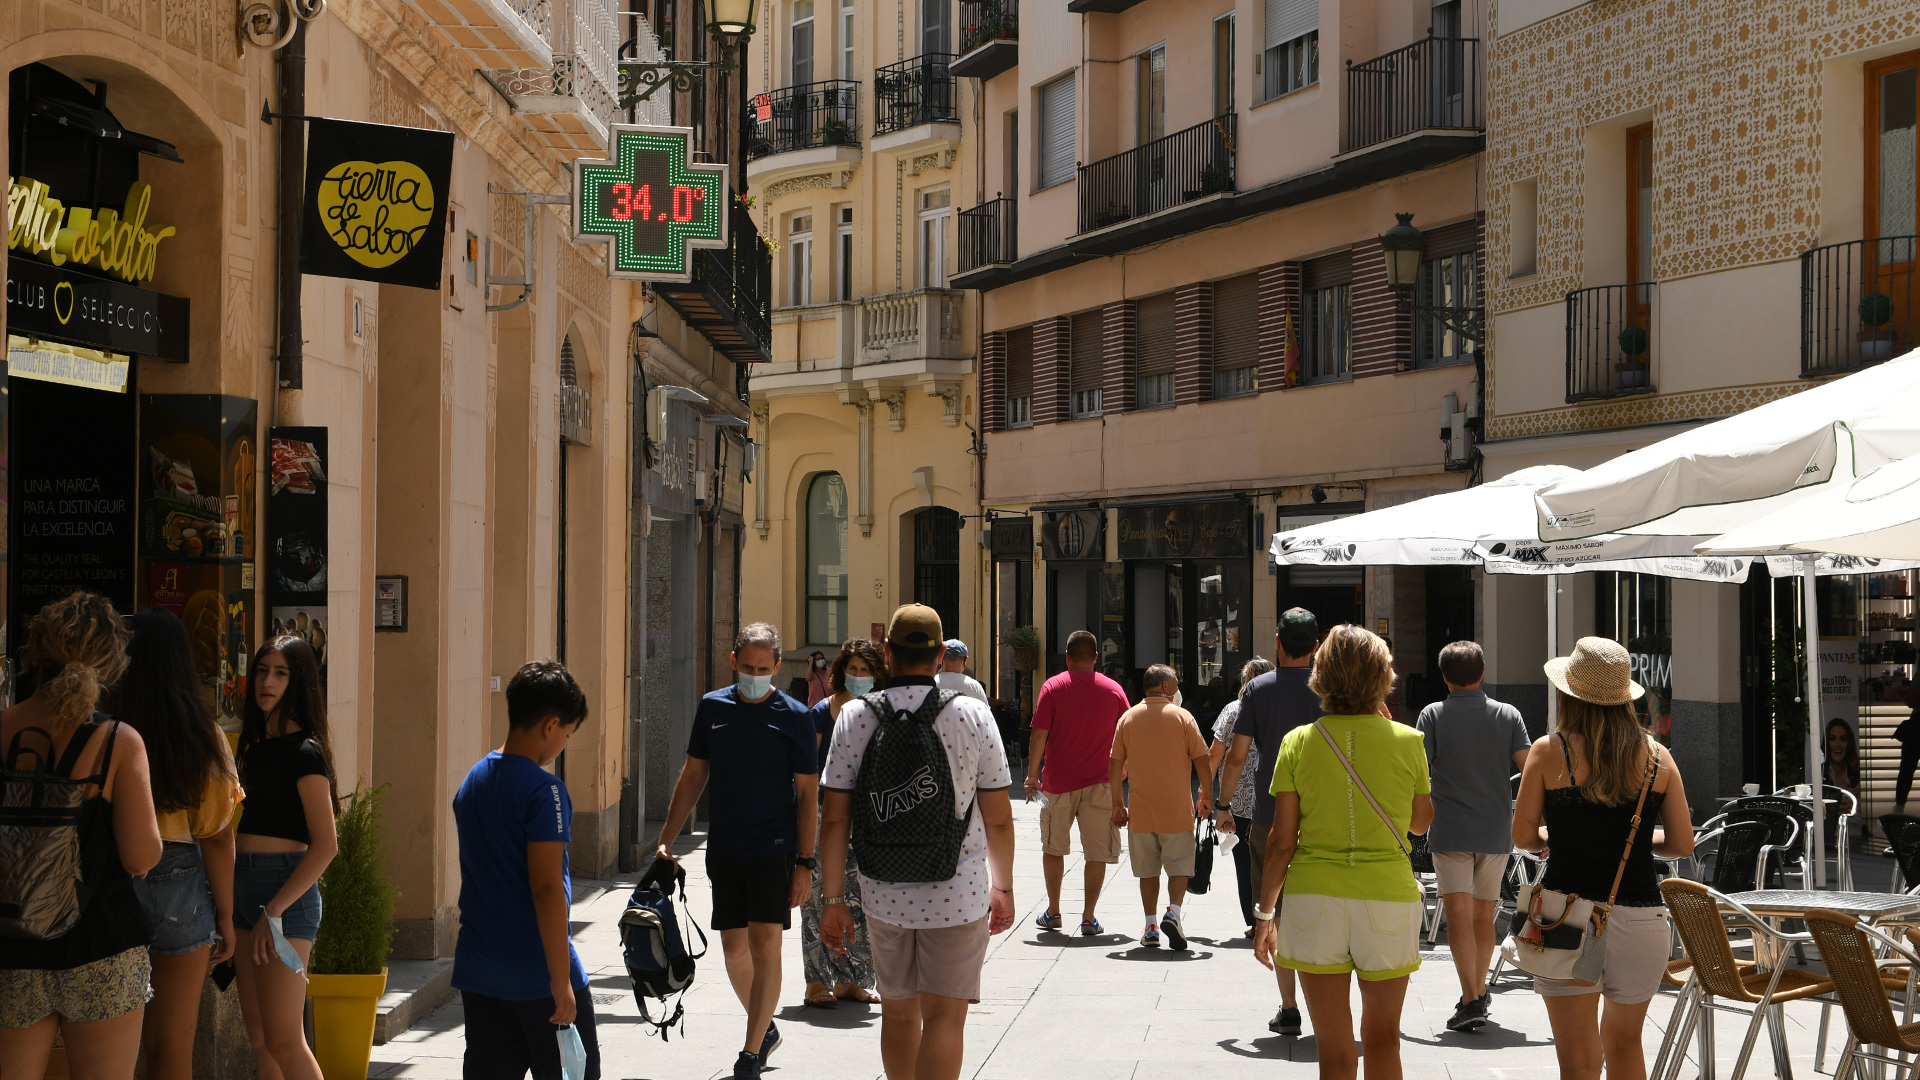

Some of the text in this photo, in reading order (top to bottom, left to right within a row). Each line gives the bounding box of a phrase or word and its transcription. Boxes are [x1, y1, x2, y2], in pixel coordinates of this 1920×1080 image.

[323, 167, 432, 211] tierra
[328, 199, 361, 222] de
[71, 207, 100, 264] de
[100, 182, 176, 282] sabor
[332, 205, 428, 255] sabor
[7, 279, 45, 309] CLUB
[9, 348, 51, 376] PRODUCTOS
[52, 353, 72, 378] 100%
[73, 357, 102, 383] CASTILLA
[104, 360, 109, 383] Y
[24, 478, 101, 493] UNA MARCA
[24, 499, 126, 515] PARA DISTINGUIR
[24, 522, 115, 536] LA EXCELENCIA
[1515, 539, 1532, 547] pepsi
[1583, 541, 1604, 549] SABOR
[22, 553, 102, 566] THE QUALITY SEAL
[1512, 545, 1551, 563] MAX
[22, 569, 39, 579] FOR
[42, 569, 81, 579] CASTILLA
[83, 569, 90, 579] Y
[22, 584, 48, 595] FINEST
[1834, 685, 1852, 694] FUERTE
[550, 784, 561, 811] PLAYER
[870, 765, 938, 822] VANS
